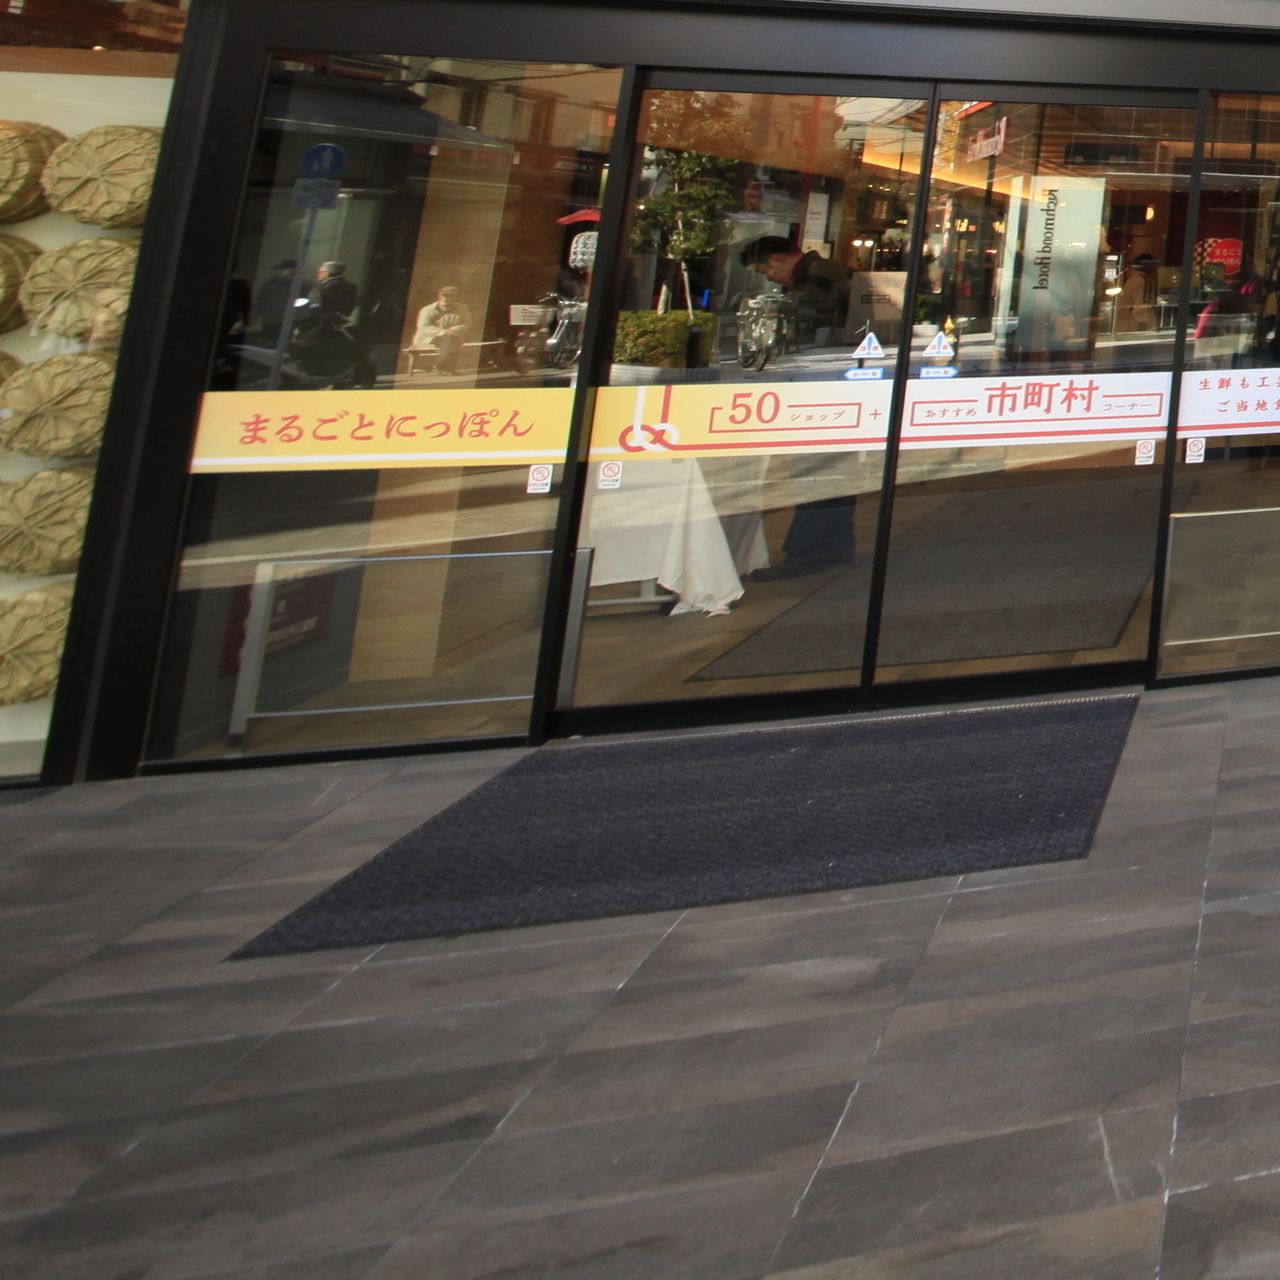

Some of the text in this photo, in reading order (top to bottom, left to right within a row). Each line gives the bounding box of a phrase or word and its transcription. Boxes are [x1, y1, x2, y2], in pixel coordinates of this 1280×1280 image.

[728, 391, 781, 425] 50
[789, 410, 846, 422] ショップ
[924, 379, 1152, 418] おすすめ 市町村 コーナー
[238, 407, 535, 446] まるごとにっぽん
